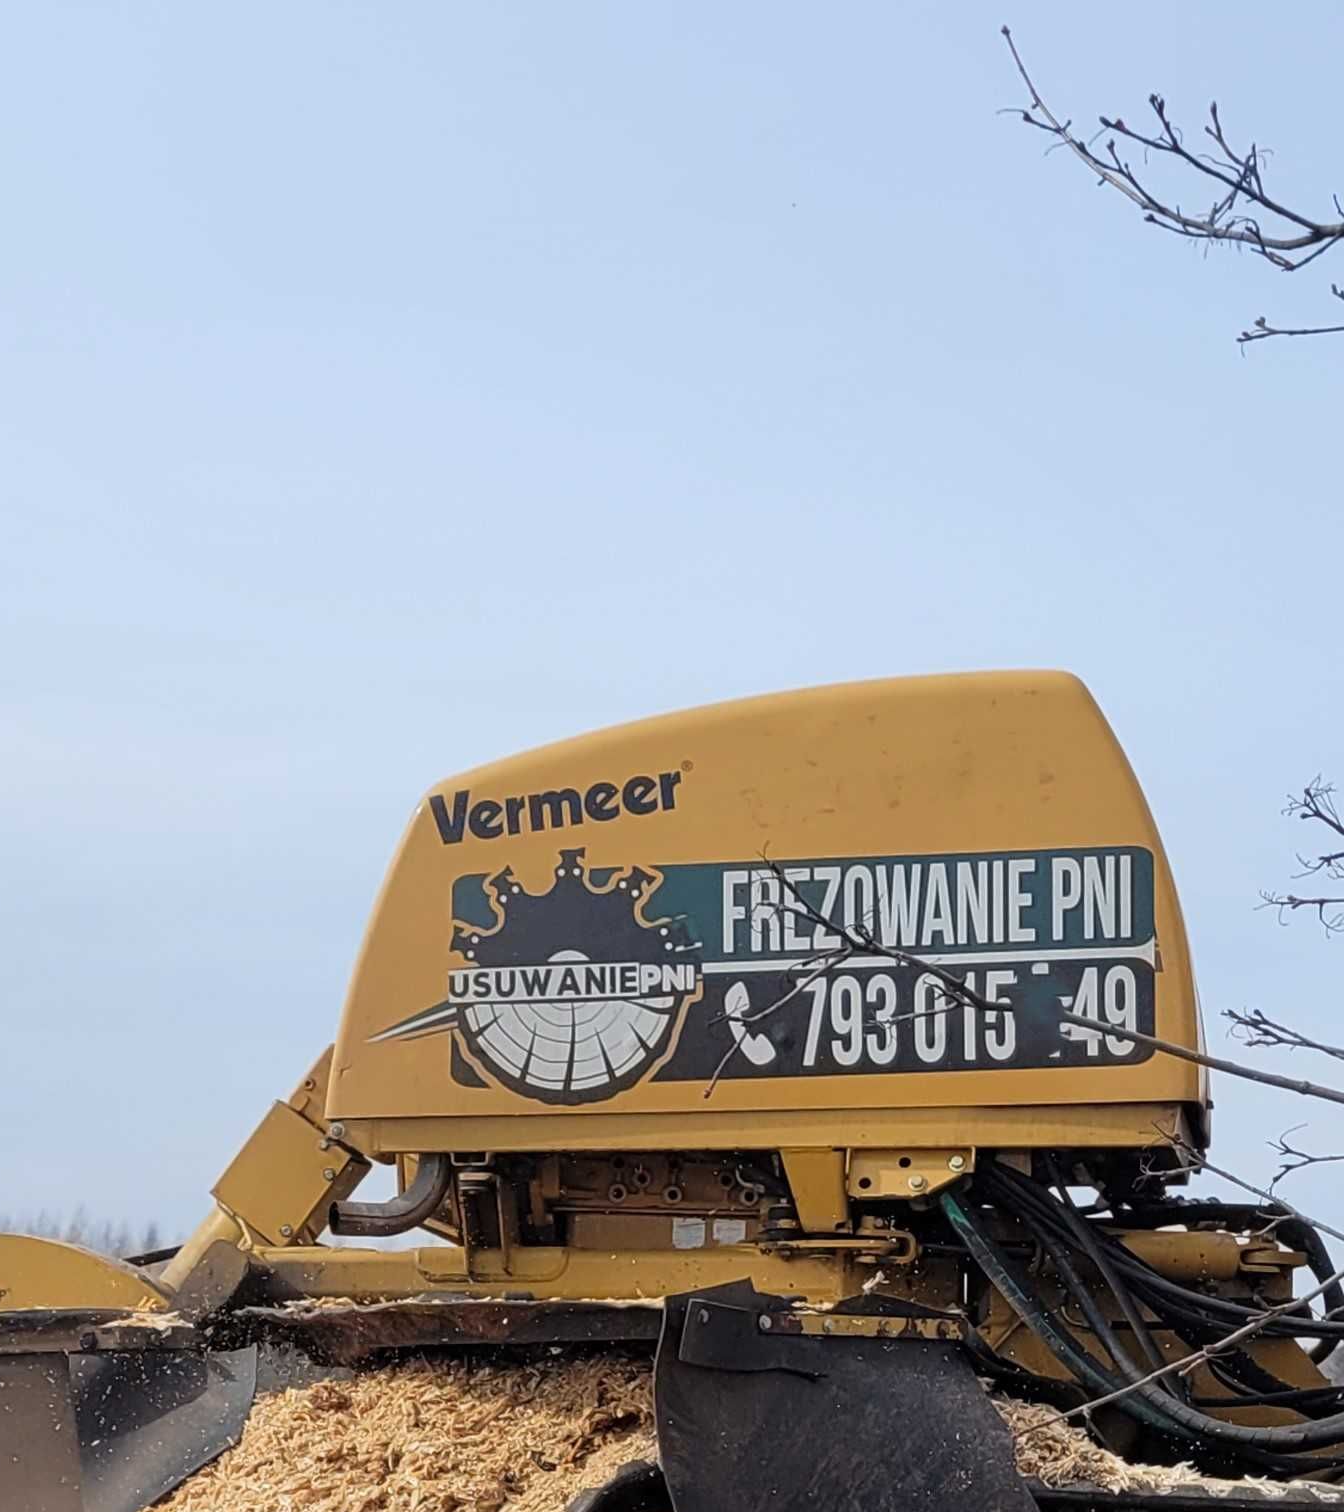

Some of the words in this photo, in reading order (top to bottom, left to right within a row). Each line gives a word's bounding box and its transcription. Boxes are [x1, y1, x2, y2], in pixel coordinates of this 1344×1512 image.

[429, 770, 682, 845] Vermeer
[721, 859, 1037, 954] FREZOWANIE
[1051, 855, 1133, 941] PNI
[797, 973, 899, 1068] 793
[913, 969, 1018, 1064] 015
[1030, 960, 1138, 1058] 49
